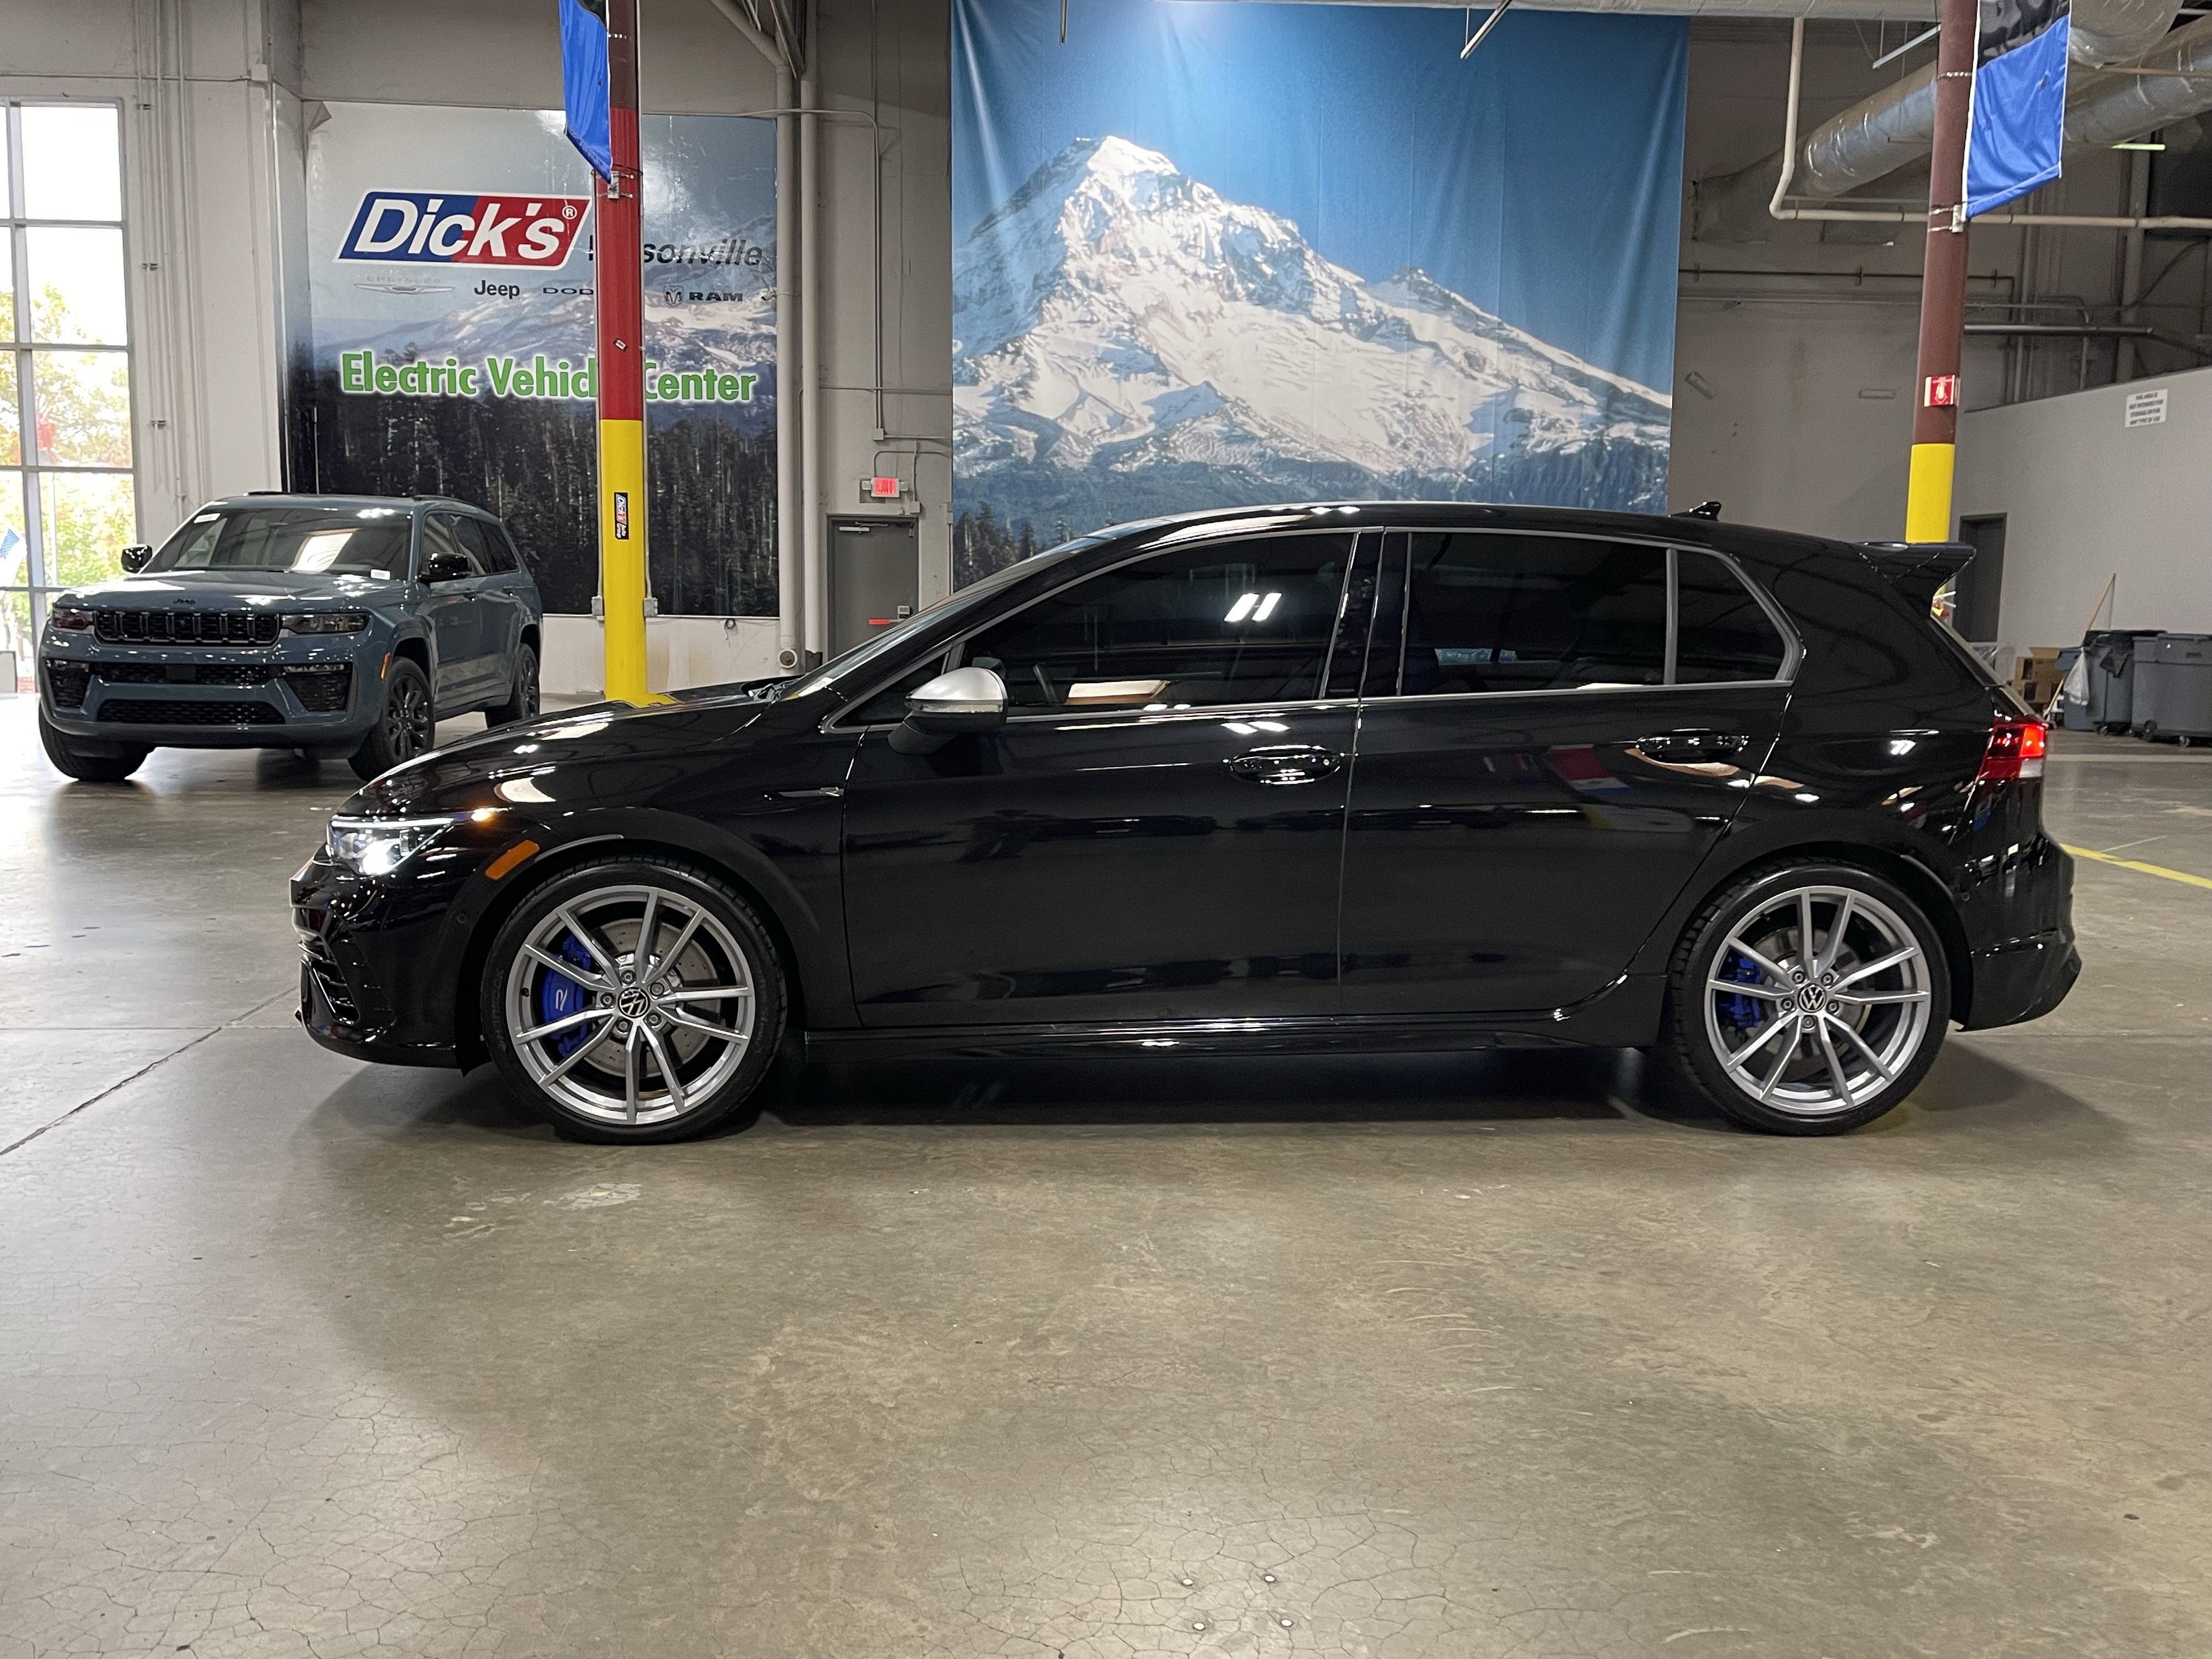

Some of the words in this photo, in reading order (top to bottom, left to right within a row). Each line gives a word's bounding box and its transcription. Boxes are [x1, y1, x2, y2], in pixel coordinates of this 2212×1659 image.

[474, 280, 521, 298] Jeep
[543, 287, 594, 295] DOD
[689, 292, 743, 302] RAM
[342, 351, 477, 395] Electric
[487, 356, 596, 398] Vehicl
